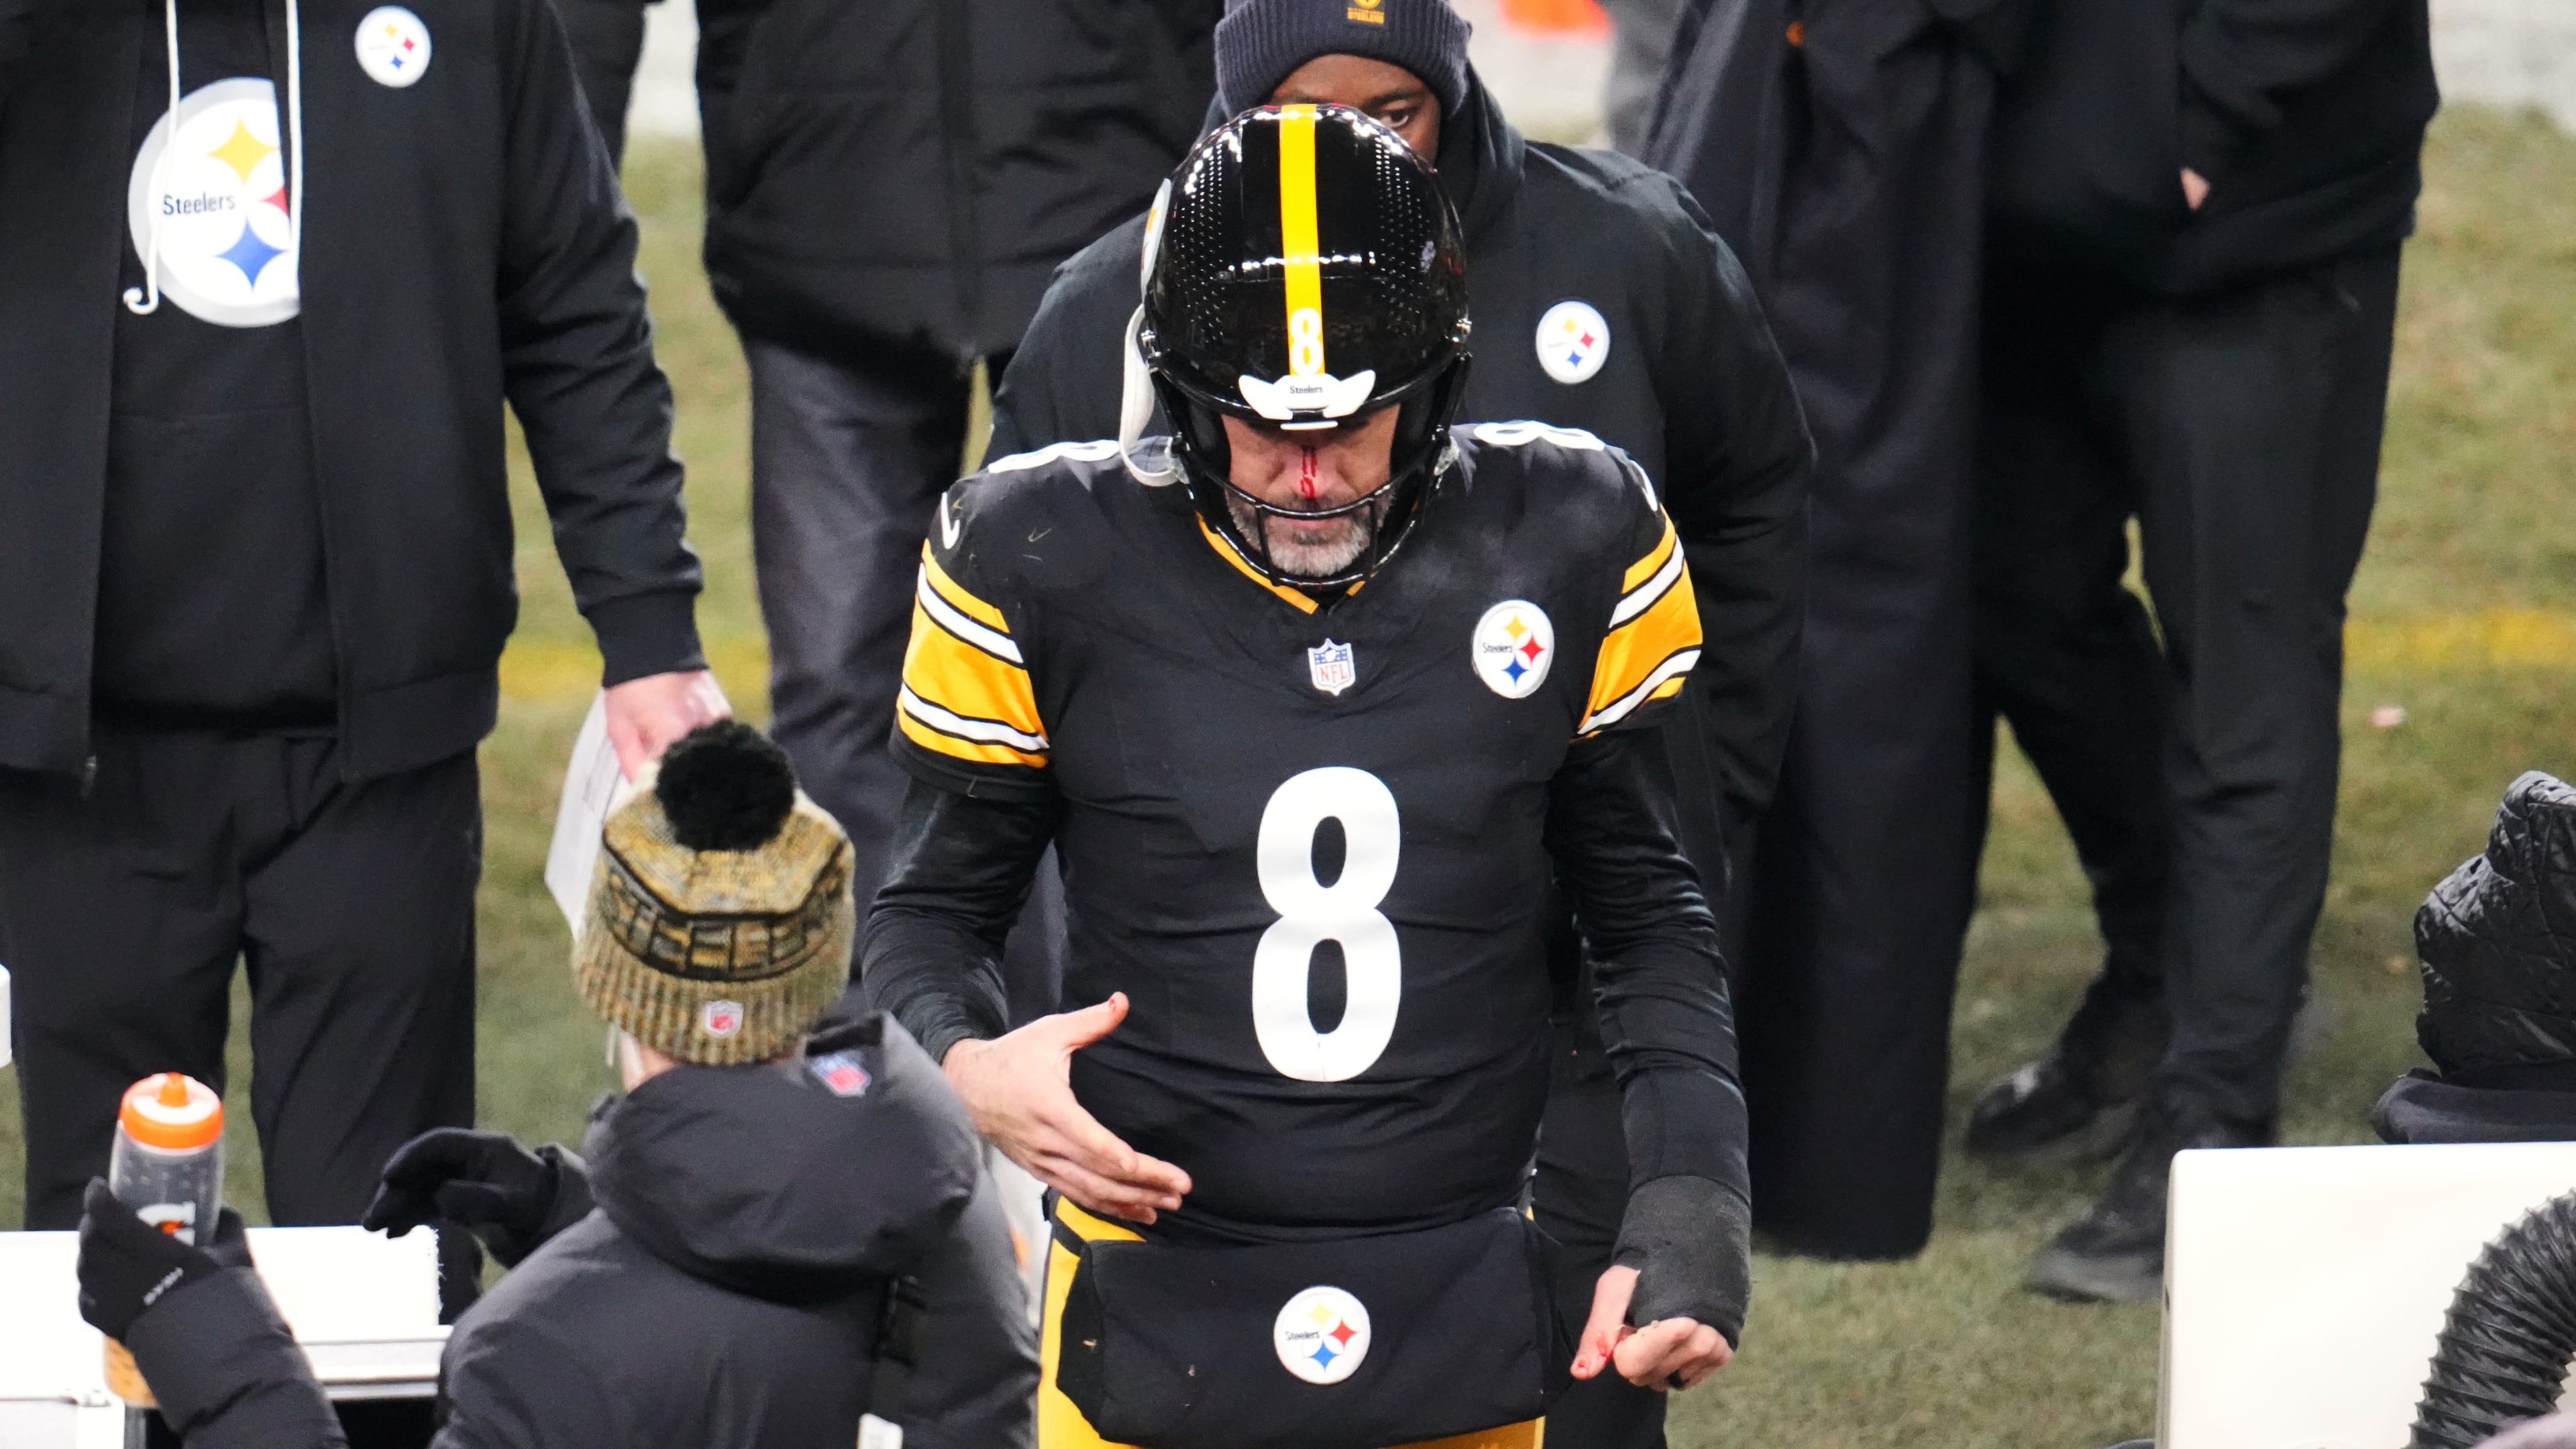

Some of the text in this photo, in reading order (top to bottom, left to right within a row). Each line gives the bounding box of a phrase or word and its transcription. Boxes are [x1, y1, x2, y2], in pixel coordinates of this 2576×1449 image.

[163, 191, 235, 215] Steelers
[1290, 307, 1323, 376] 8
[1289, 385, 1323, 394] Steelers
[1483, 642, 1513, 653] Steelers
[1320, 663, 1348, 683] NFL
[1252, 766, 1401, 1082] 8
[1285, 1330, 1320, 1341] Steelers
